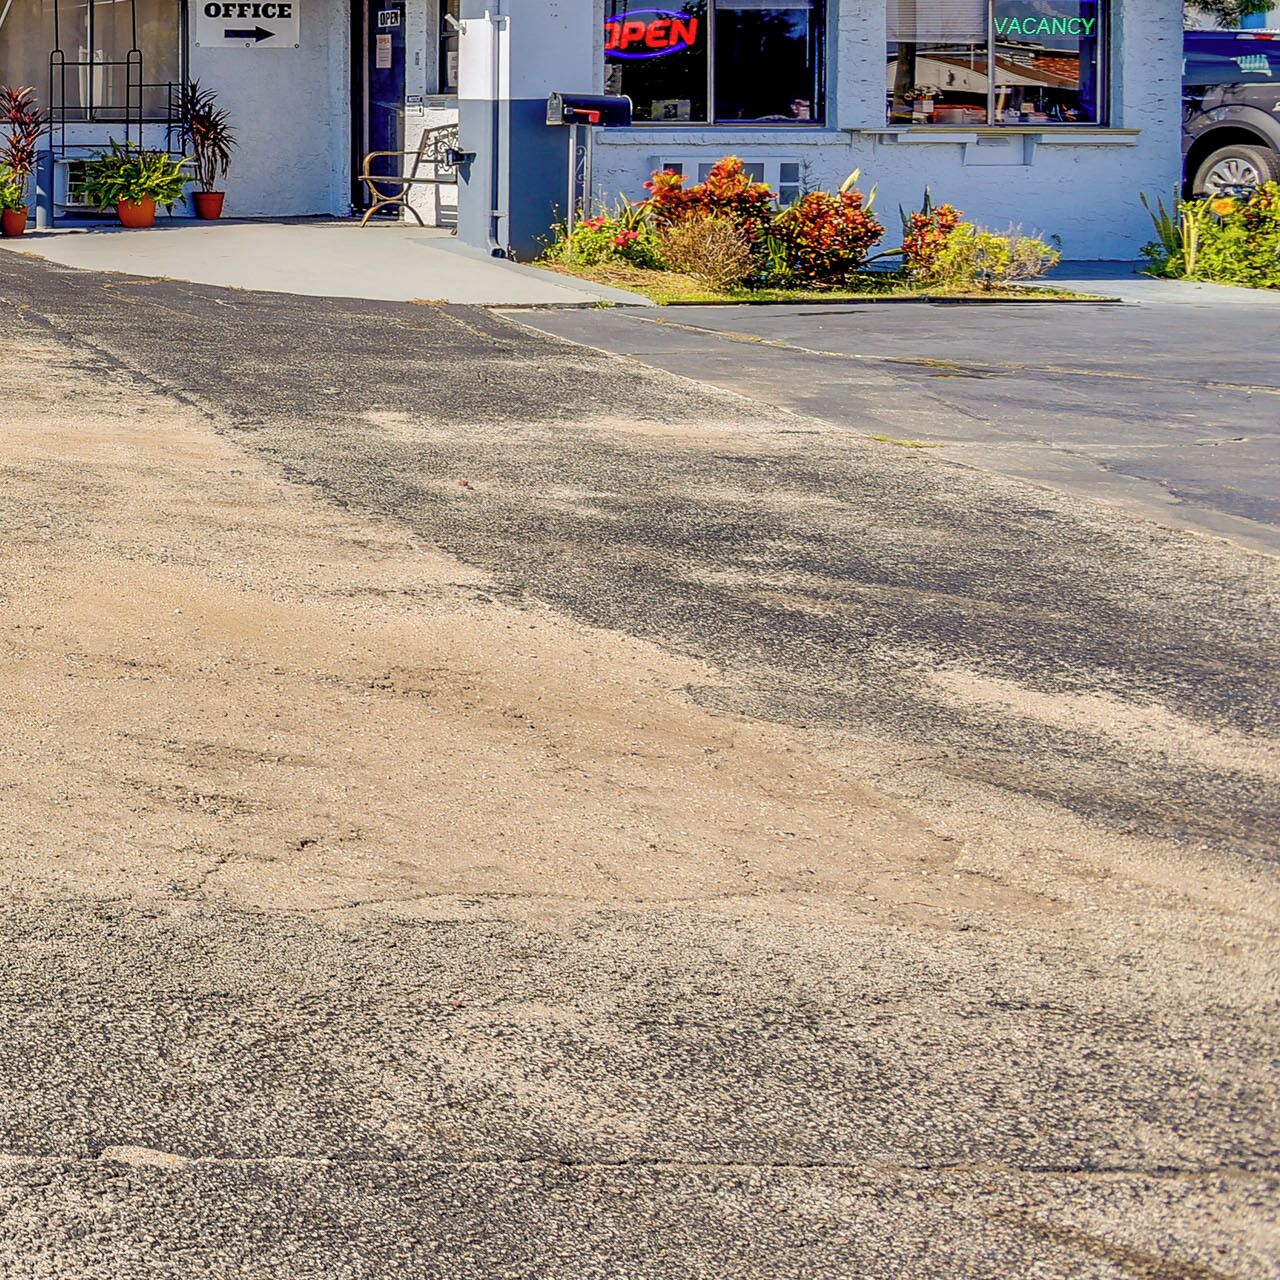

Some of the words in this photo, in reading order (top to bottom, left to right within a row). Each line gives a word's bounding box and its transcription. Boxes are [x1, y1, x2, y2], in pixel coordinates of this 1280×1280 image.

[203, 2, 292, 19] OFFICE
[380, 11, 400, 26] OPEN
[993, 17, 1096, 35] VACANCY
